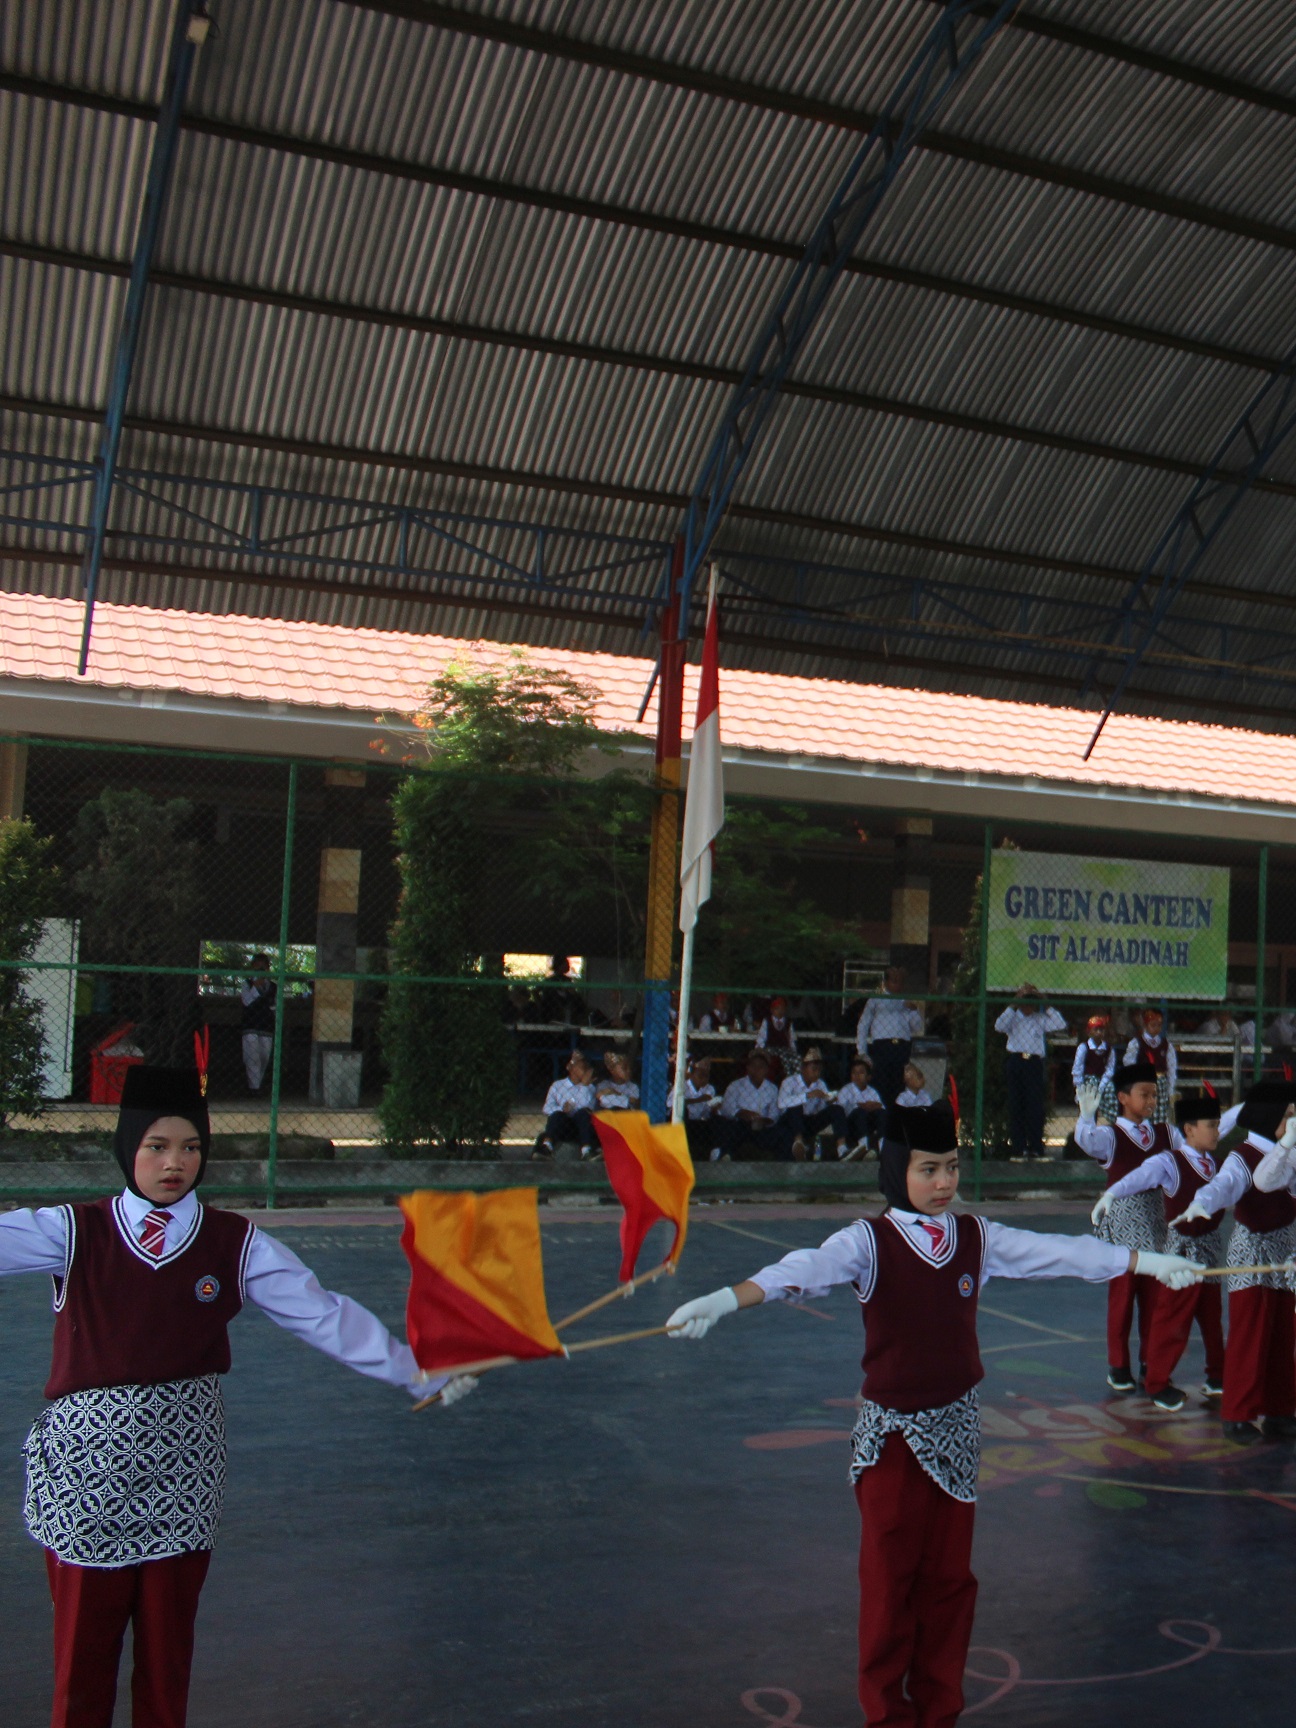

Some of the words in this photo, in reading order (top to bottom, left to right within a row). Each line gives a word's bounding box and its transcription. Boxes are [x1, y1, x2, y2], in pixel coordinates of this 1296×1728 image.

[1004, 885, 1092, 922] GREEN
[1097, 891, 1213, 929] CANTEEN
[1027, 934, 1060, 961] SIT
[1065, 936, 1190, 967] AL-MADINAH
